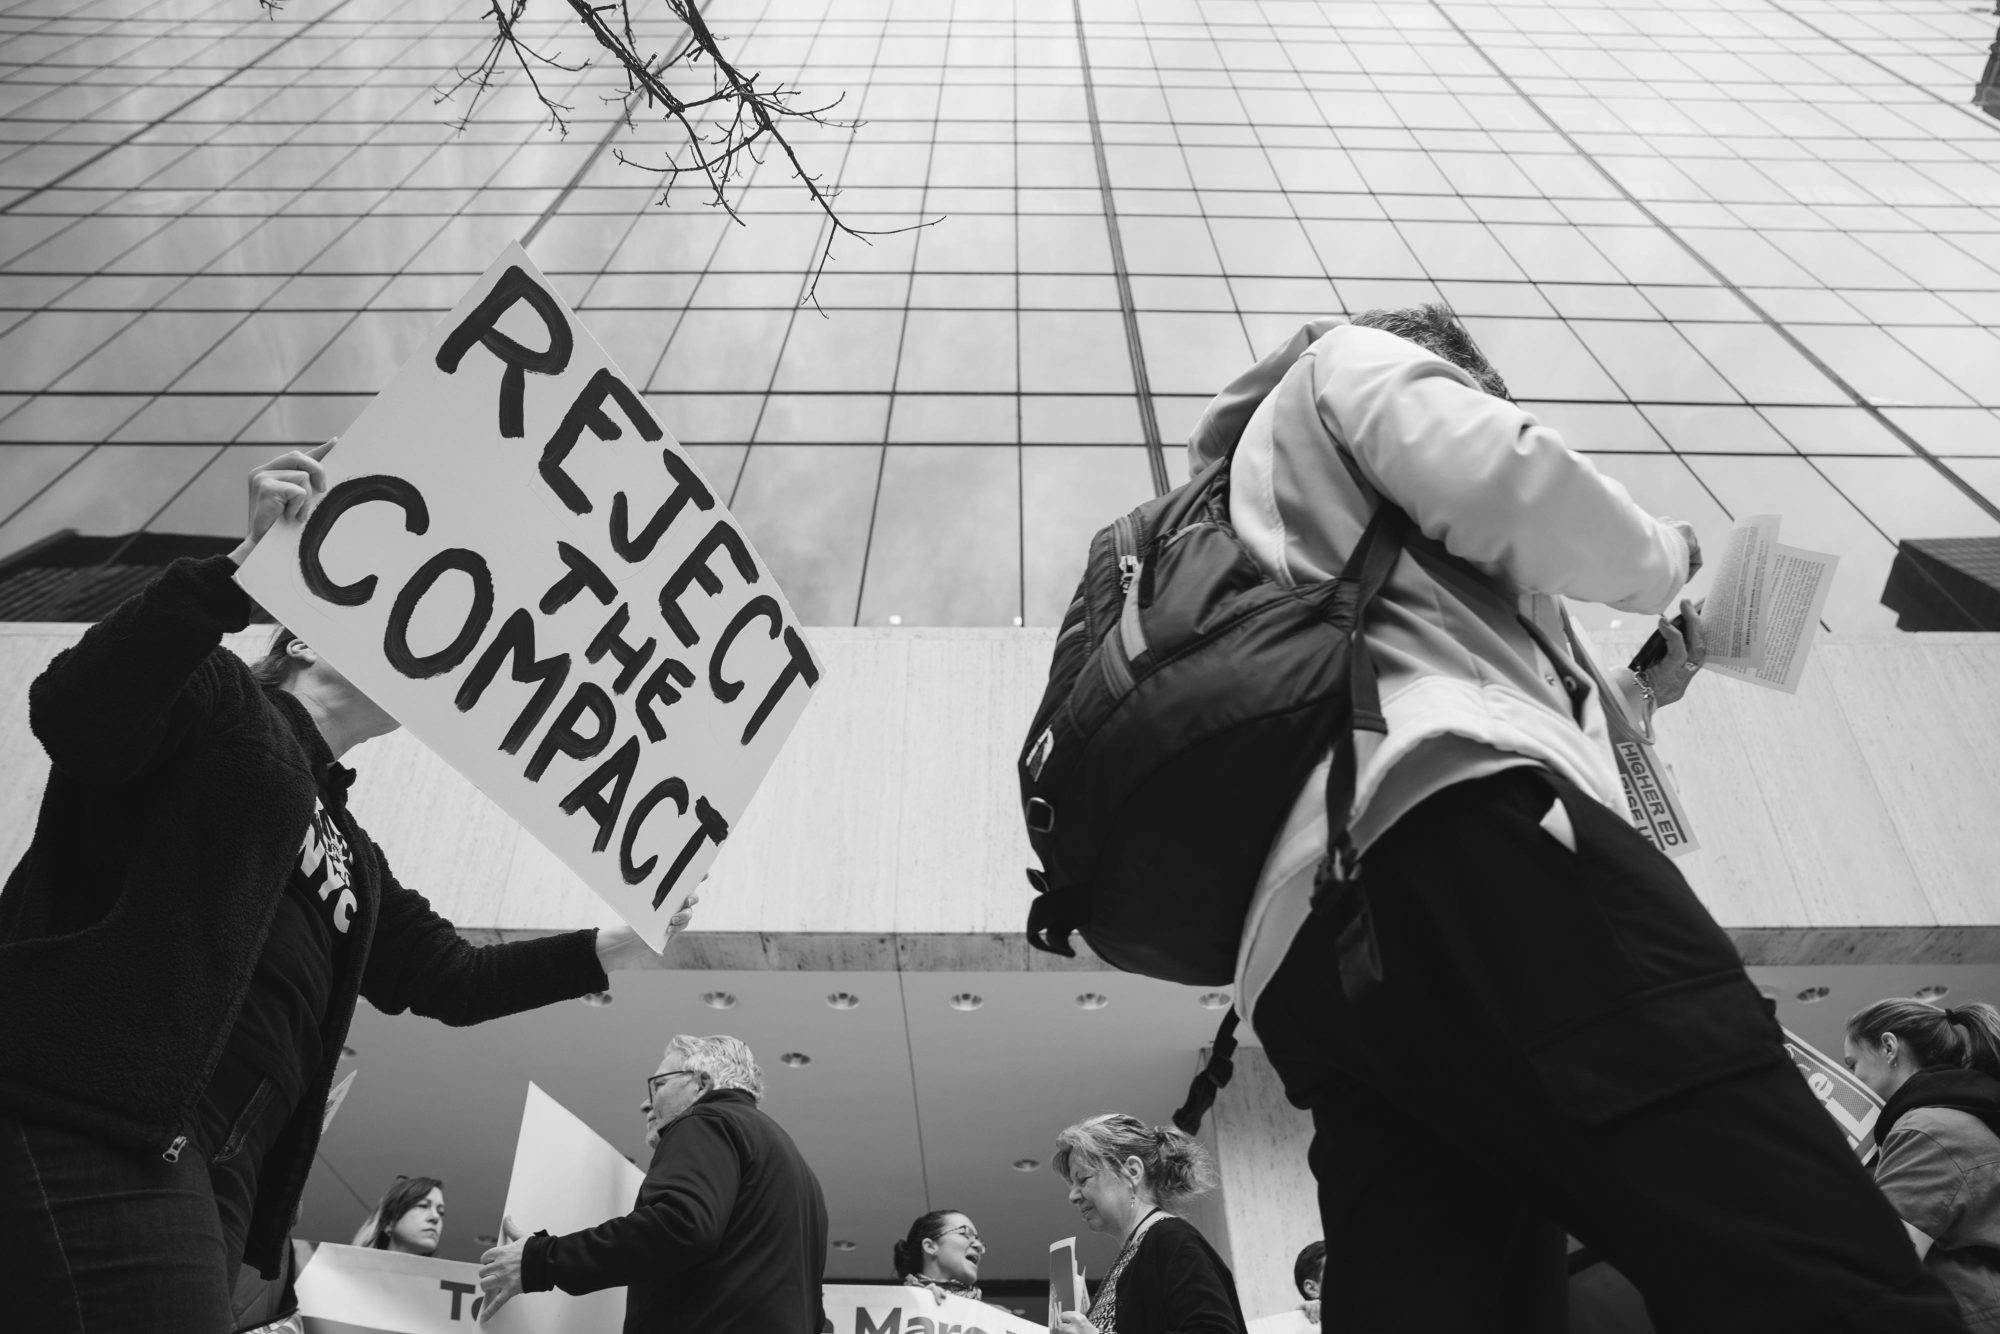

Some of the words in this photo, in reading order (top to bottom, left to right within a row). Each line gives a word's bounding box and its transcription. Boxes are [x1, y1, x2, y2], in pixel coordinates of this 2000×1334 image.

[435, 265, 820, 746] REJECT
[298, 474, 730, 912] COMPACT
[538, 540, 697, 744] THE
[297, 822, 358, 934] NYC
[1620, 743, 1666, 817] HIGHER
[1657, 820, 1679, 847] ED
